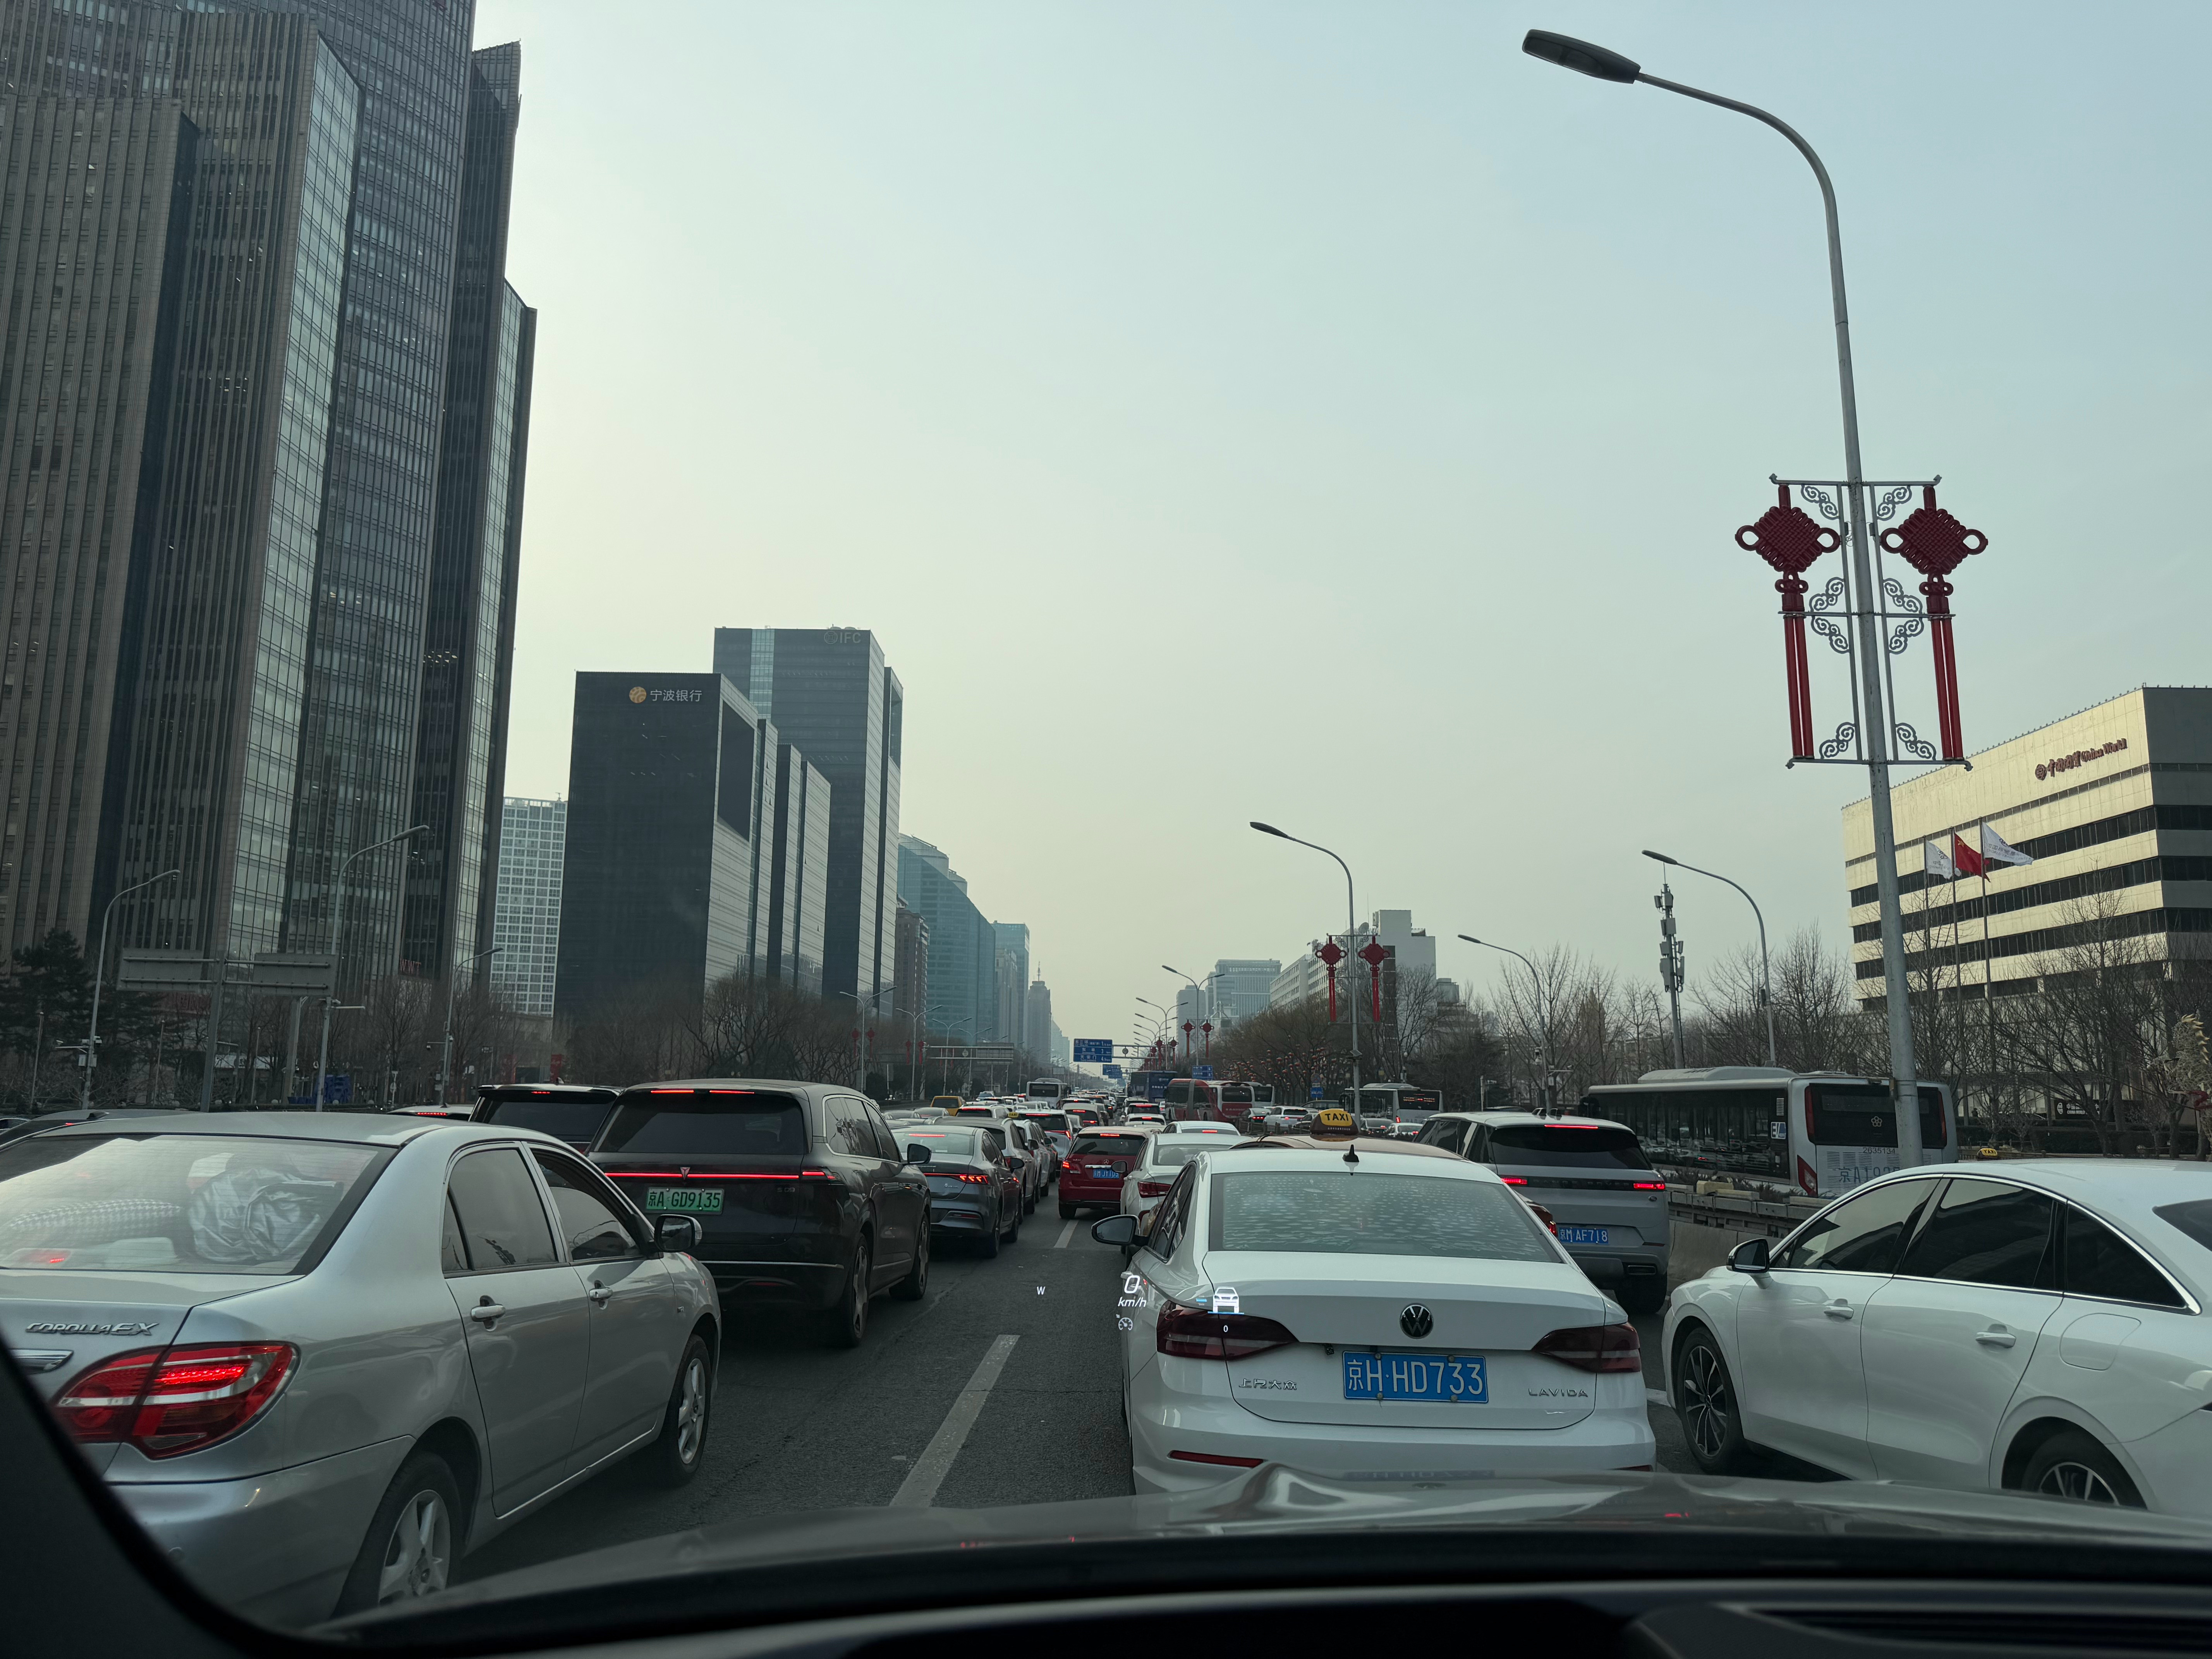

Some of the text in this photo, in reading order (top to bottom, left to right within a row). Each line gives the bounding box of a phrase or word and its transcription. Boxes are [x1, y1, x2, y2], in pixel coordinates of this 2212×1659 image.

[840, 632, 861, 643] IFC
[650, 689, 702, 702] 宁波银行
[1325, 1113, 1348, 1121] TAXI
[1124, 1275, 1140, 1293] 0
[1037, 1286, 1046, 1295] W
[1118, 1297, 1147, 1308] km/h
[1239, 1378, 1297, 1390] 上汽大众
[1528, 1388, 1588, 1397] LAVIDA
